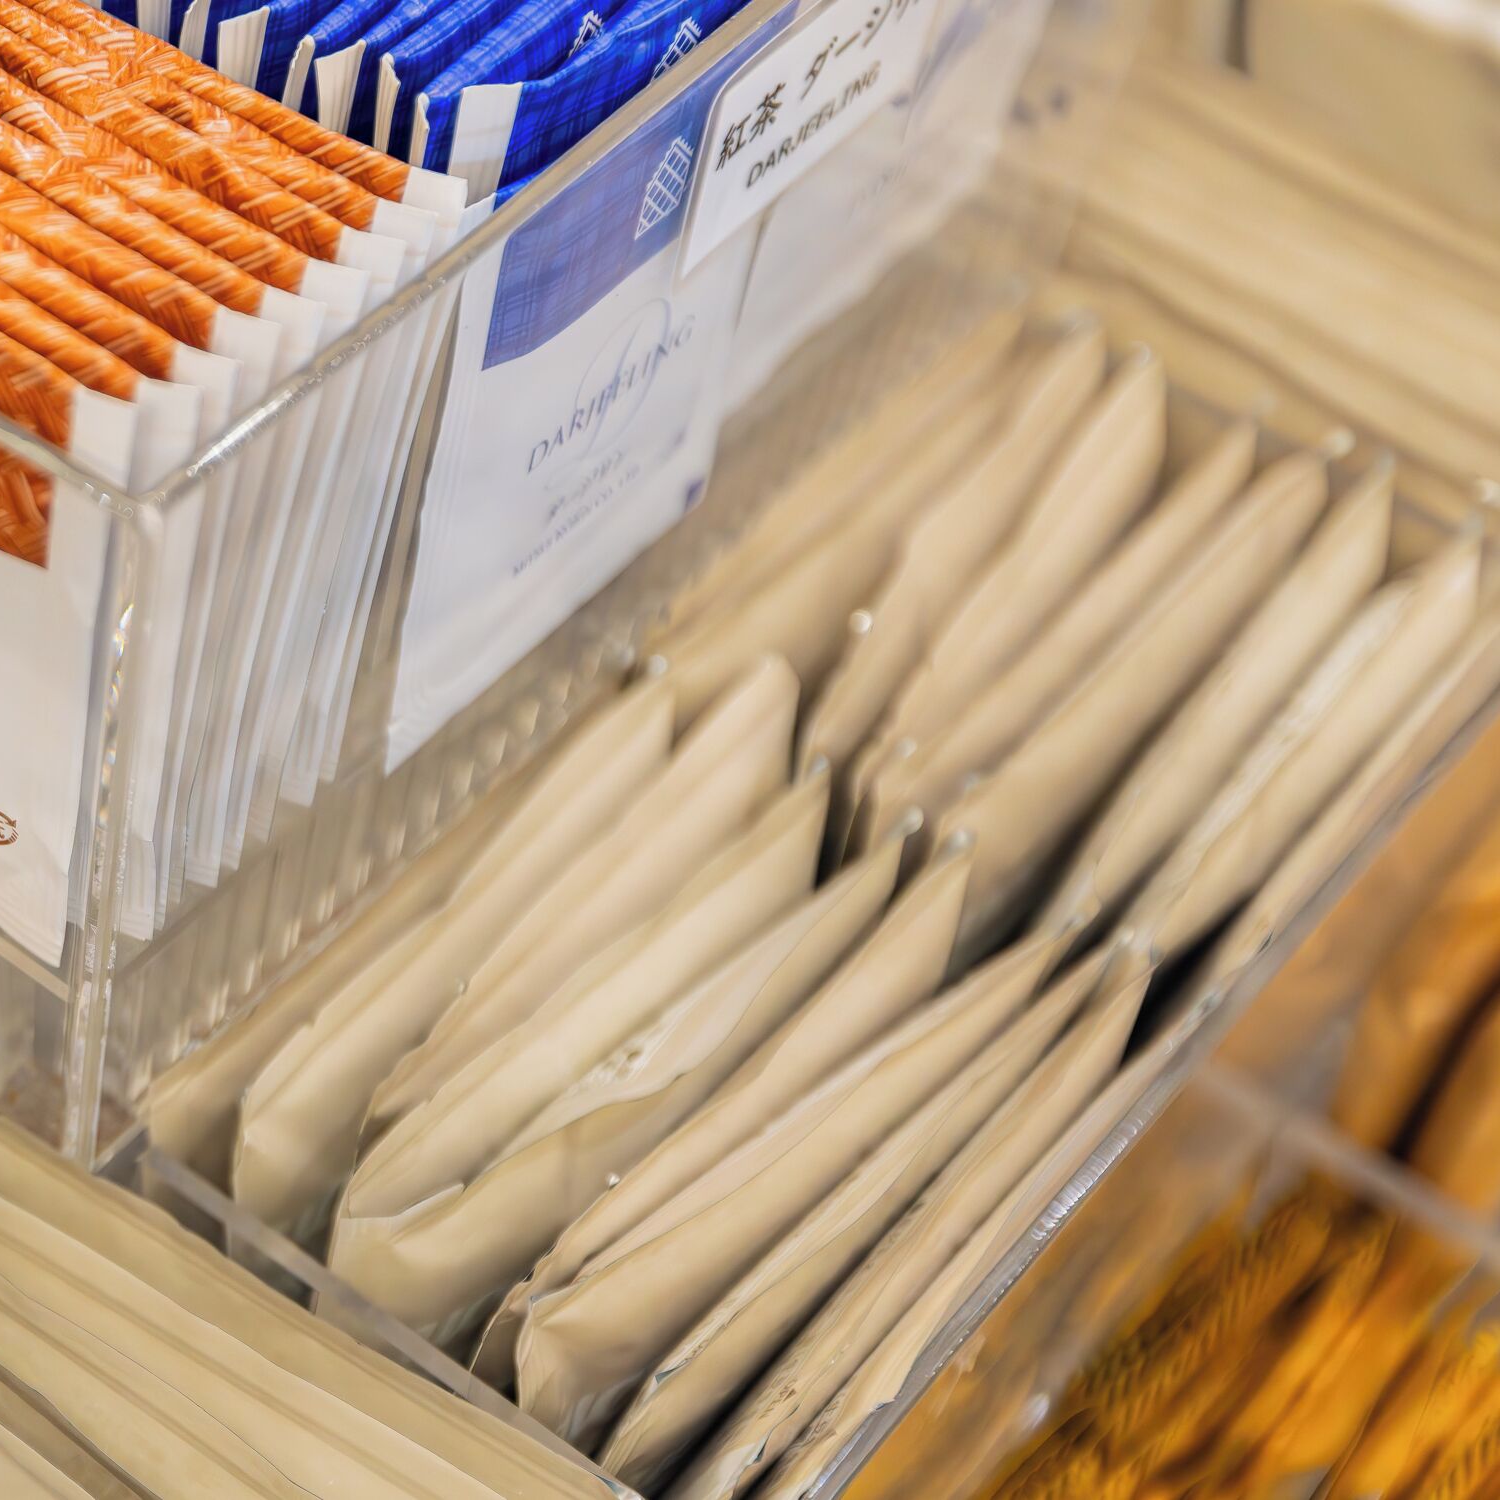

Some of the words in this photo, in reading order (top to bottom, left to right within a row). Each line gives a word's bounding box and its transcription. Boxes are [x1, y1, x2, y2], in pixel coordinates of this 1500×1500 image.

[716, 83, 786, 171] 紅茶
[801, 0, 918, 100] ダージ
[746, 61, 881, 188] DARJEELING
